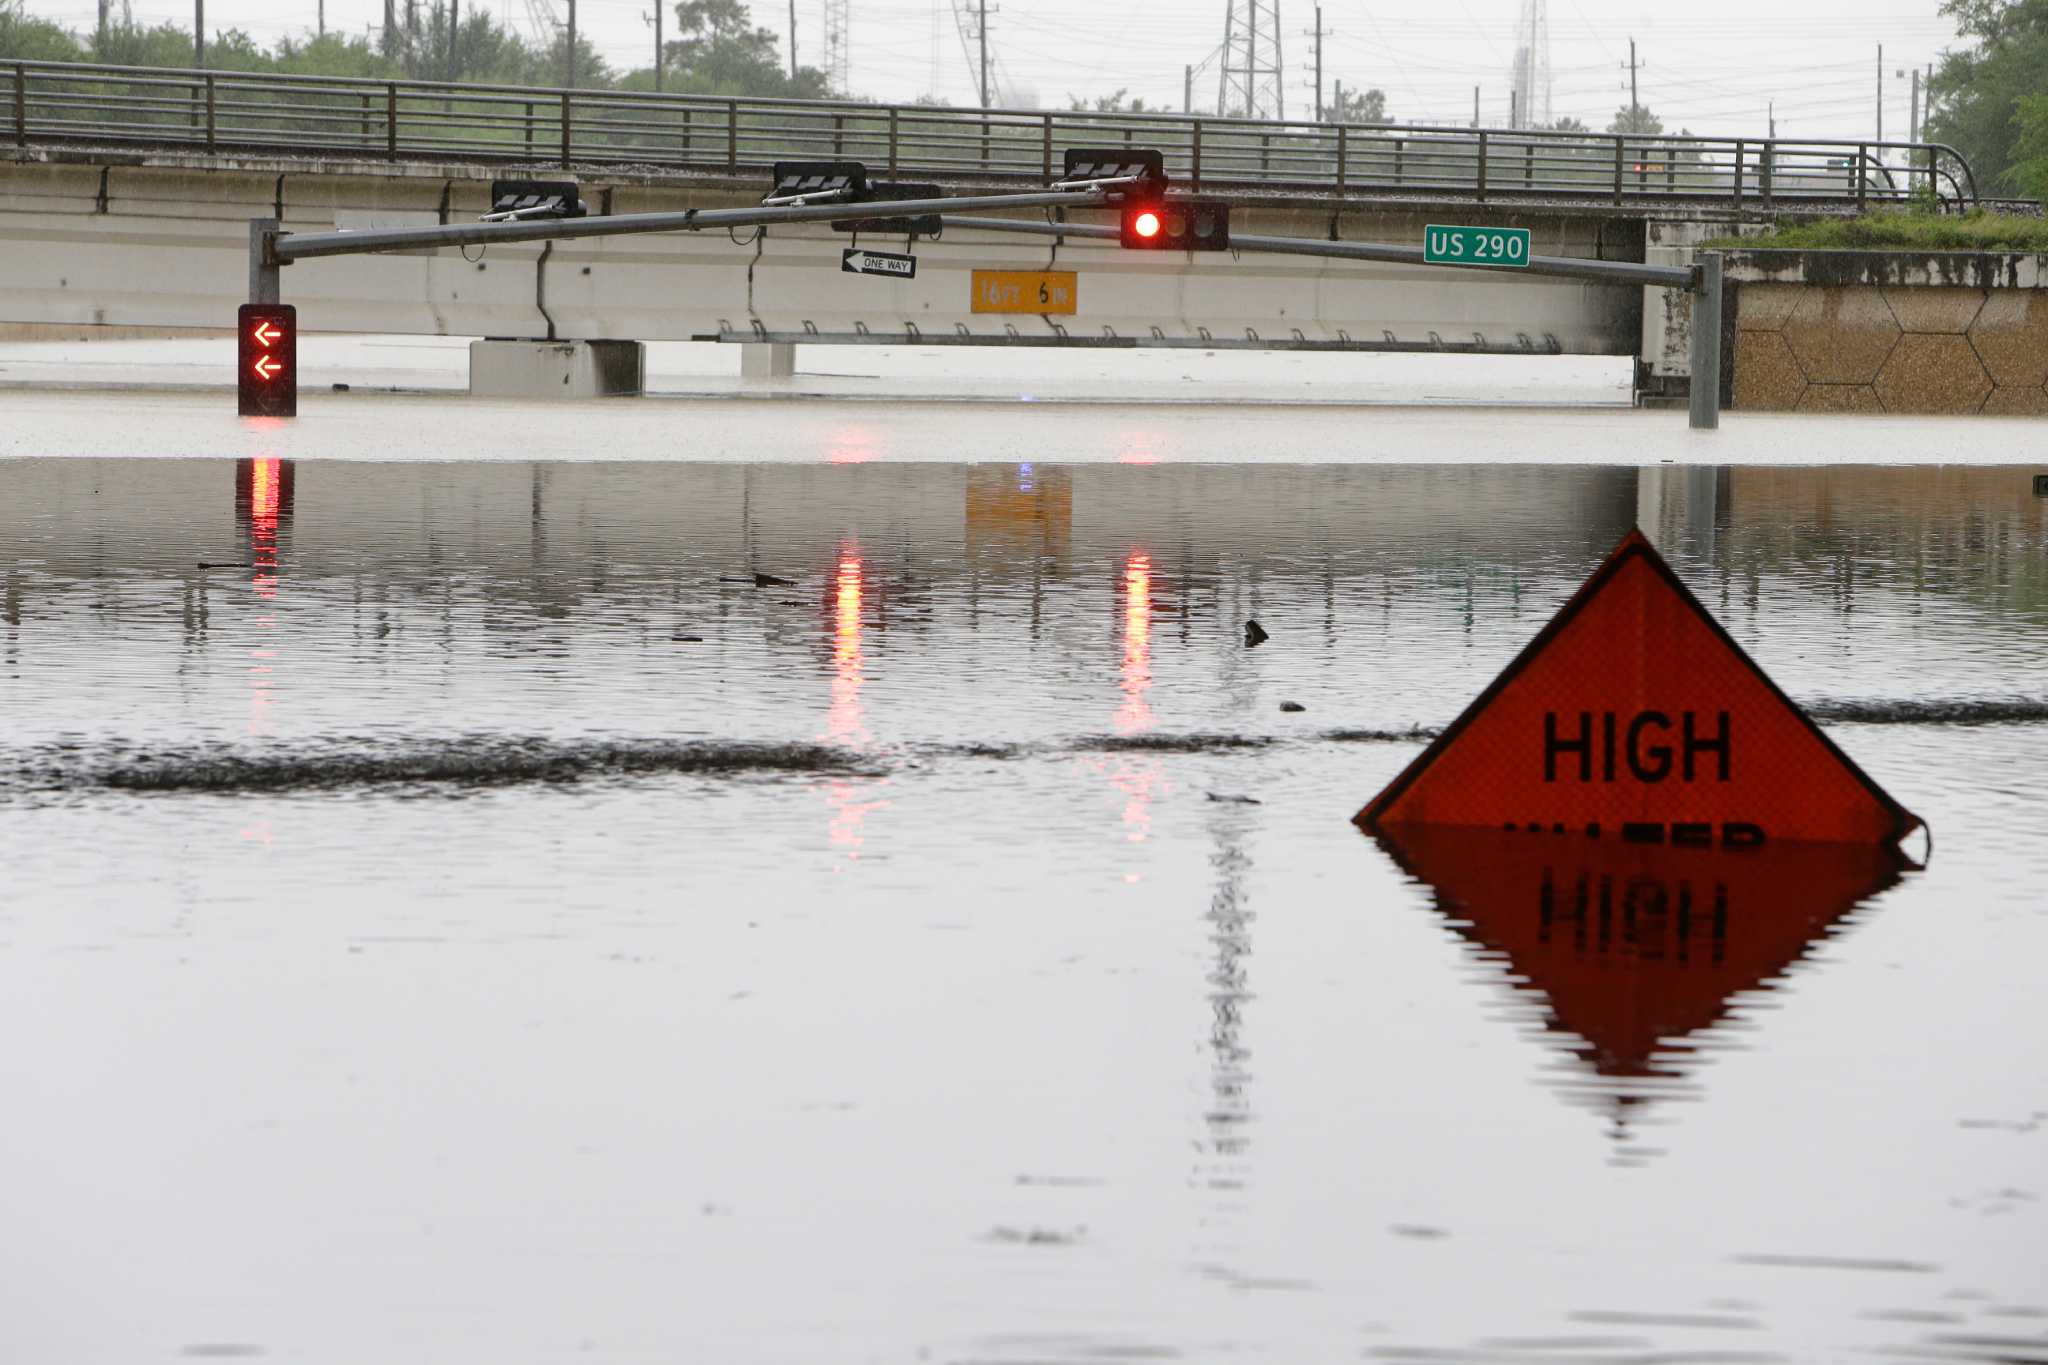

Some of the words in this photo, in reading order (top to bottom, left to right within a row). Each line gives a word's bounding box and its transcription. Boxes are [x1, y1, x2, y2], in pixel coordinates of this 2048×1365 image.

[1431, 232, 1464, 256] US
[1474, 234, 1523, 259] 290
[864, 258, 884, 269] ONE
[887, 260, 909, 272] WAY
[1544, 711, 1731, 783] HIGH
